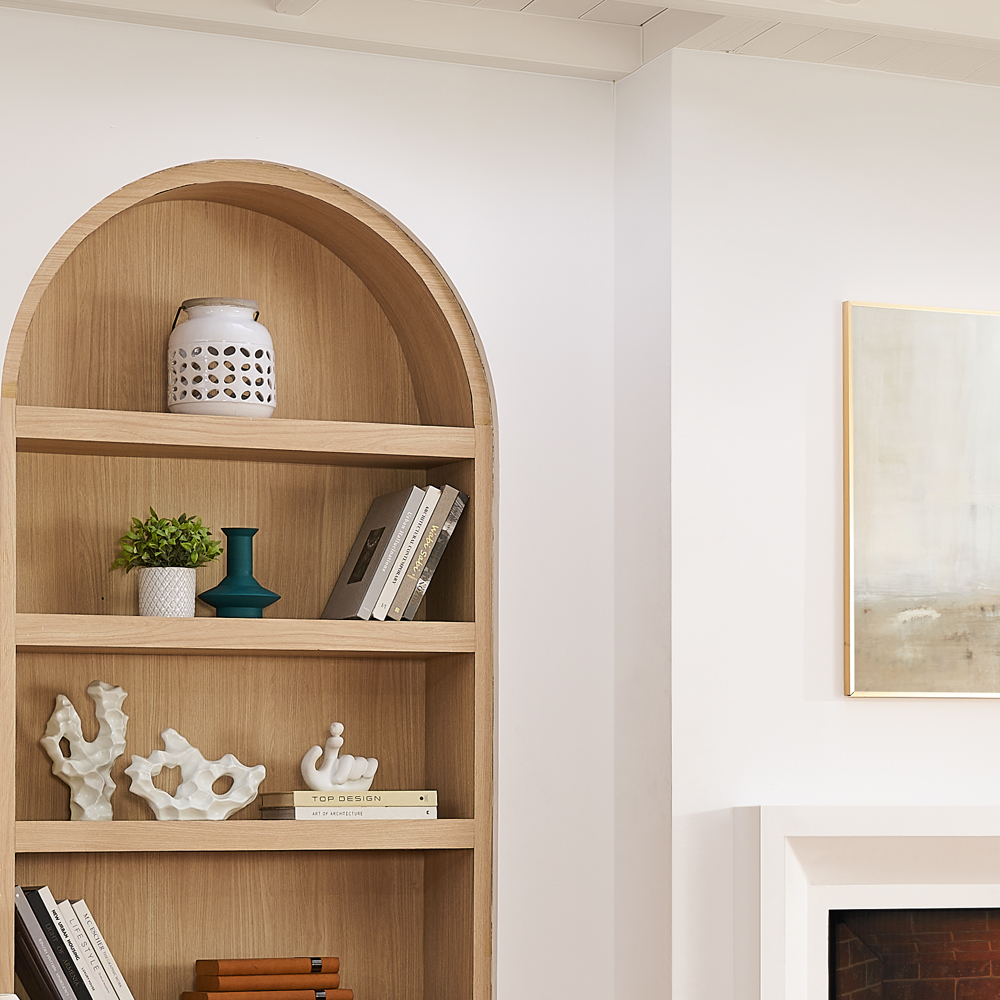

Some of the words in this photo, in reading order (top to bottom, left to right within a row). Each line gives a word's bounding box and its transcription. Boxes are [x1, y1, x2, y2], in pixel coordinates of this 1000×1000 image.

[401, 511, 413, 530] Urban
[409, 506, 430, 545] ARCHITECTURAL
[423, 524, 439, 550] Wabi
[381, 530, 404, 572] Hallucinations
[392, 545, 412, 585] CONTEMPORARY
[412, 549, 428, 573] Sabi
[51, 909, 60, 921] NEW
[58, 921, 69, 939] URBAN
[67, 939, 81, 961] HOUSING
[69, 918, 84, 940] LIFE
[80, 941, 99, 972] STYLE
[89, 926, 105, 951] ESCHER
[45, 923, 58, 943] LIGHT
[56, 945, 64, 955] OF
[62, 958, 80, 987] ARMENIA
[55, 972, 70, 997] CALIFORNIA
